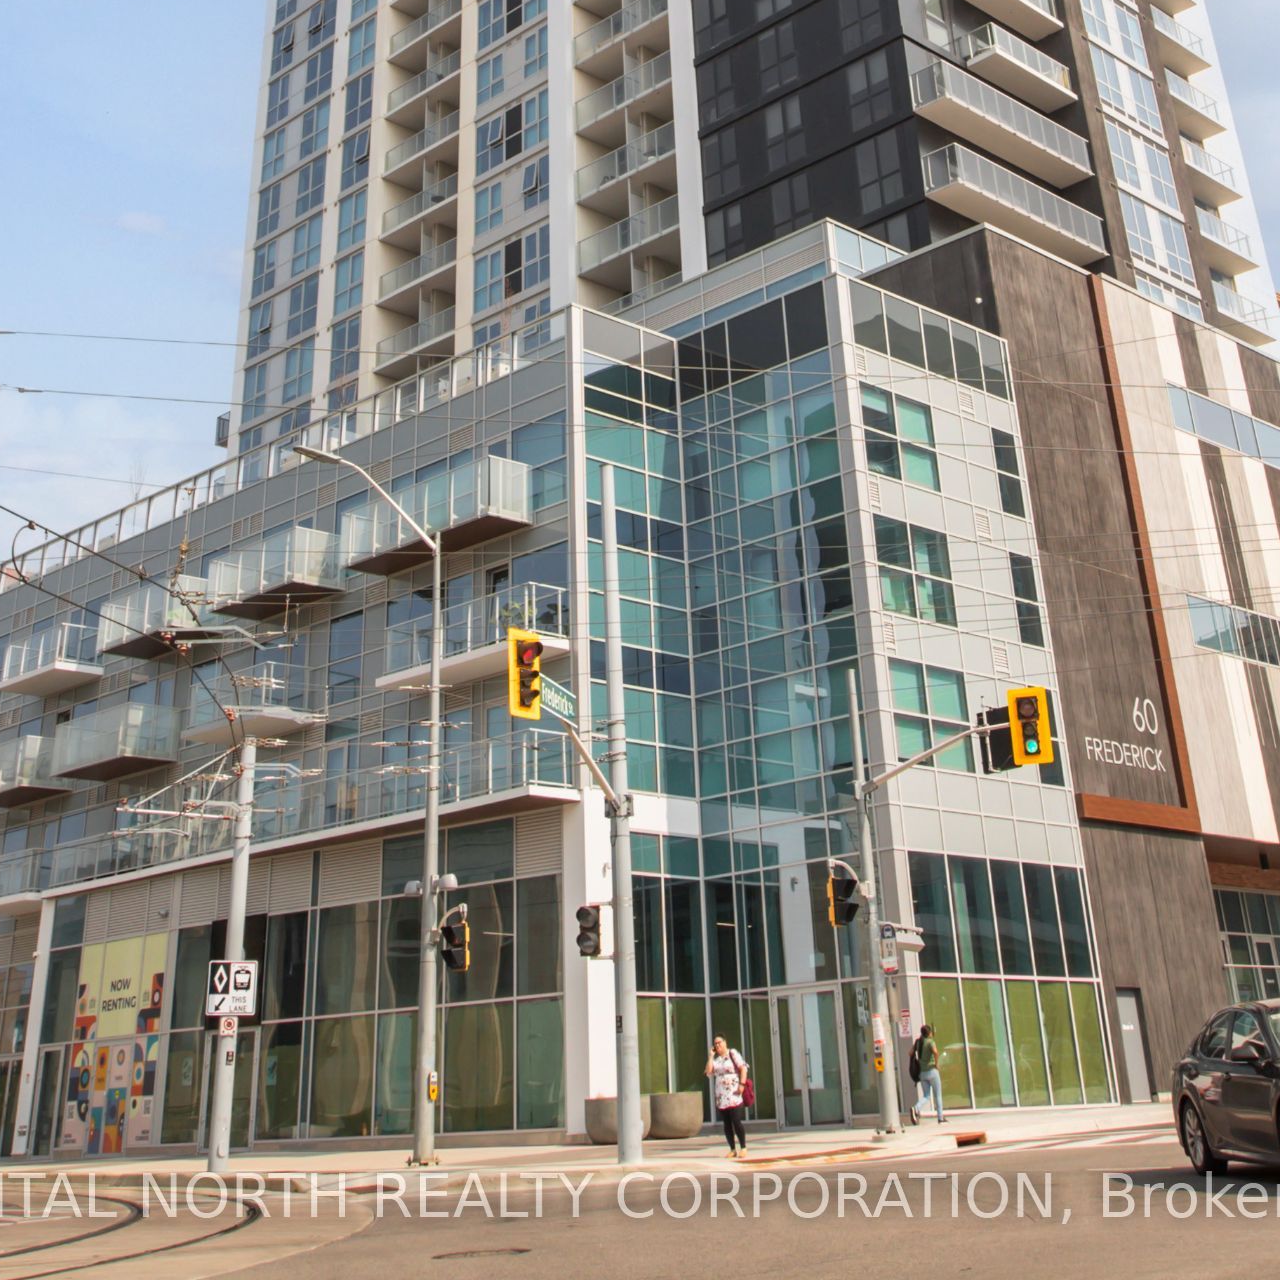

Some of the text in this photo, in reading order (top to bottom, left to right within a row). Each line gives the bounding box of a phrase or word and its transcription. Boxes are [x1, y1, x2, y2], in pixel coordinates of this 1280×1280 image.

[542, 682, 569, 717] Frederick
[1132, 696, 1159, 735] 60
[1084, 736, 1167, 773] FREDERICK
[110, 978, 132, 993] NOW
[101, 996, 137, 1012] RENTING
[231, 996, 247, 1004] THIS
[228, 1005, 247, 1013] LANE
